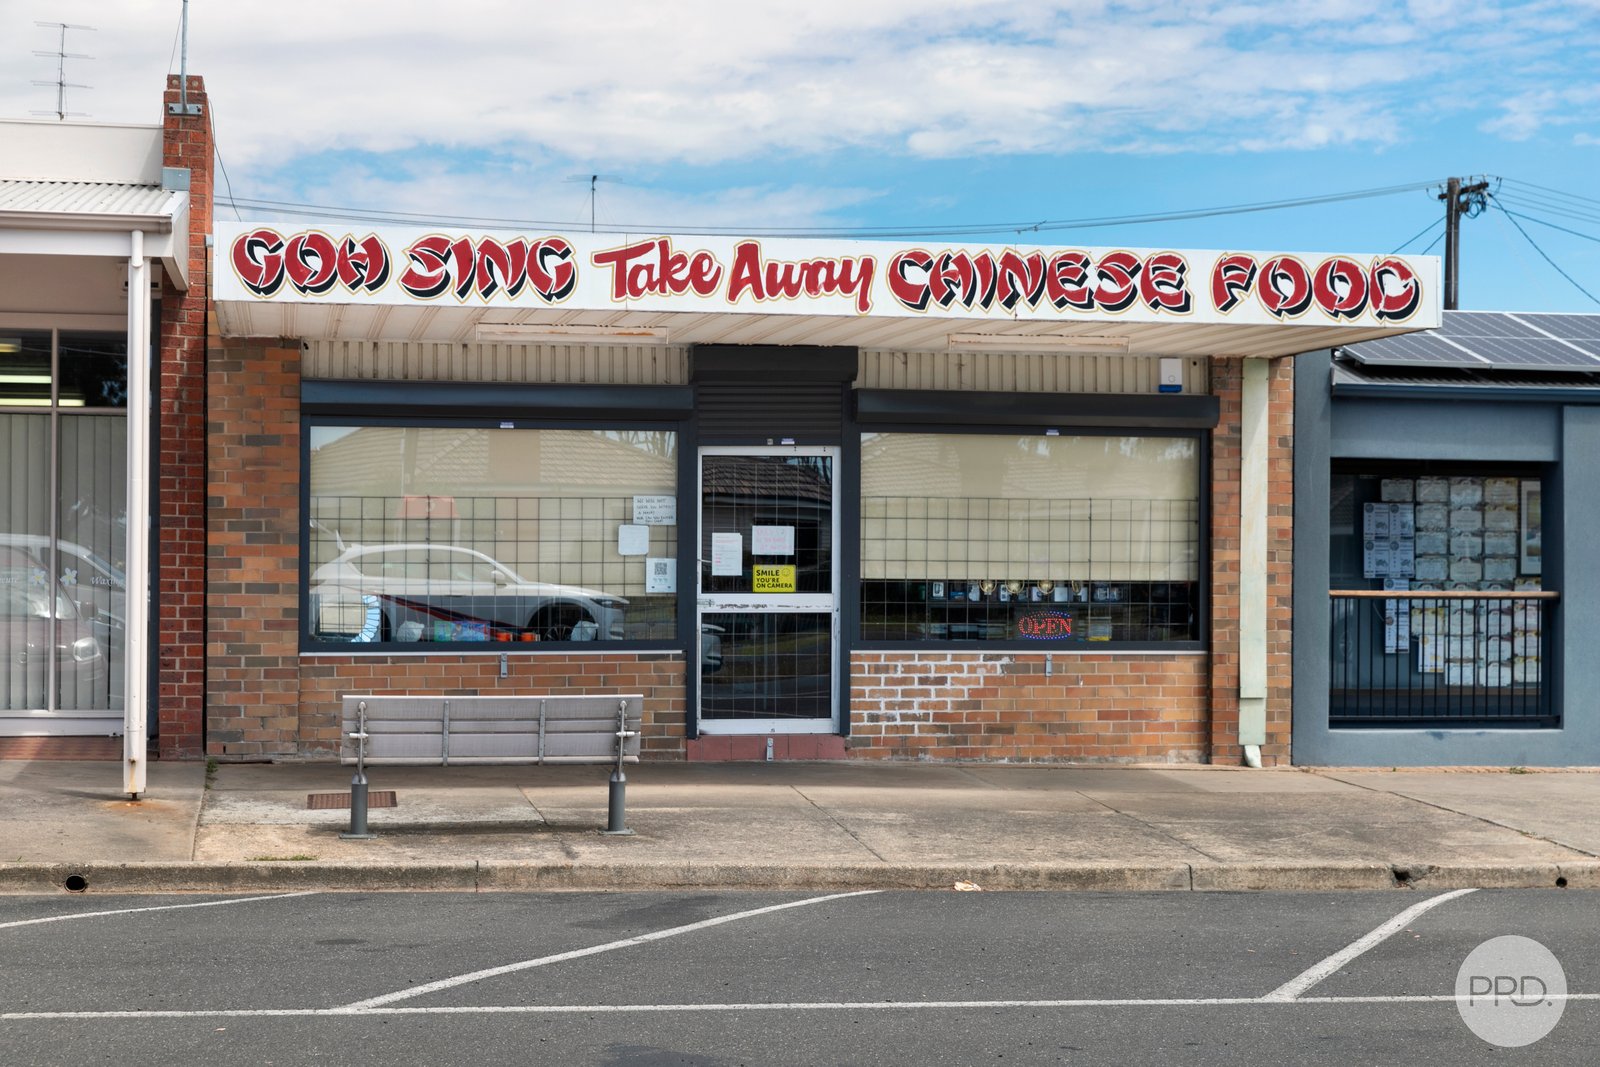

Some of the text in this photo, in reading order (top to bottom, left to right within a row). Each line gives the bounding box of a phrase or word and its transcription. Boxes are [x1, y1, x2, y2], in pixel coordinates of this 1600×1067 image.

[232, 229, 1422, 323] GOH SING Take Away CHINESE FOOD
[1018, 616, 1073, 635] OPEN
